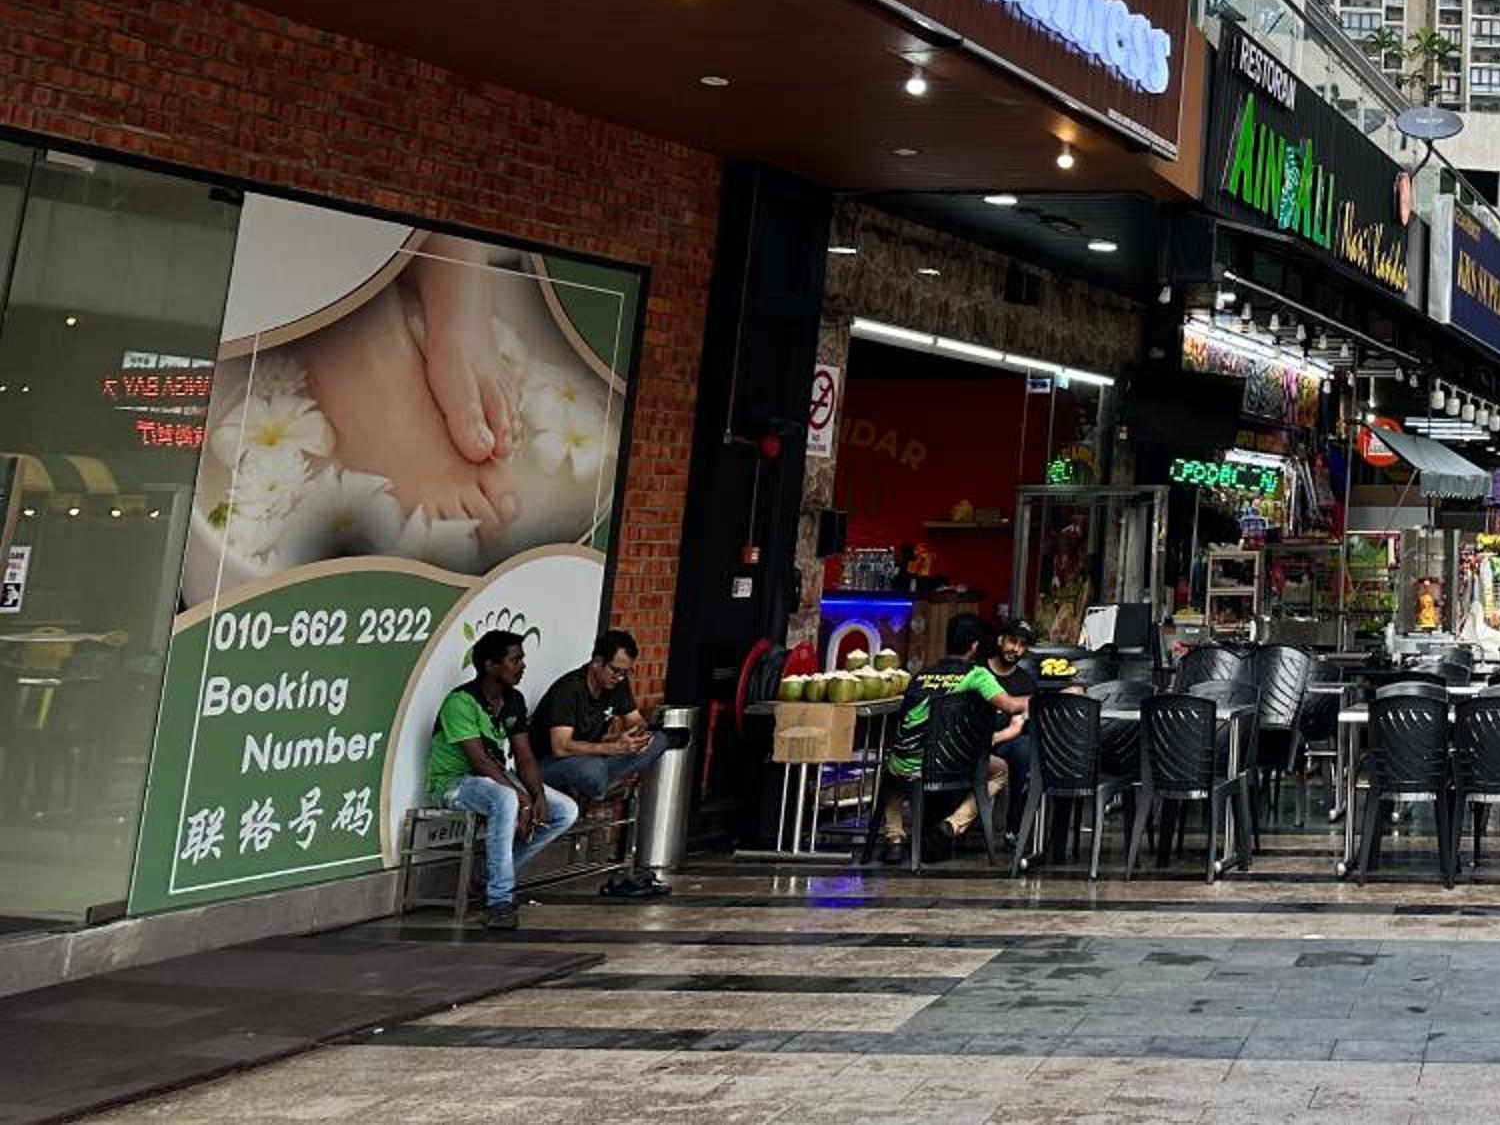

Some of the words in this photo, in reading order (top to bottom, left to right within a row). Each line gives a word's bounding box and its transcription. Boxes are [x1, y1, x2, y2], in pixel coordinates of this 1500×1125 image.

[1239, 42, 1297, 112] RESTORAN
[214, 609, 347, 651] 010-662
[357, 607, 432, 644] 2322
[202, 671, 349, 717] Booking
[241, 727, 382, 774] Number
[180, 786, 376, 863] 联络号码
